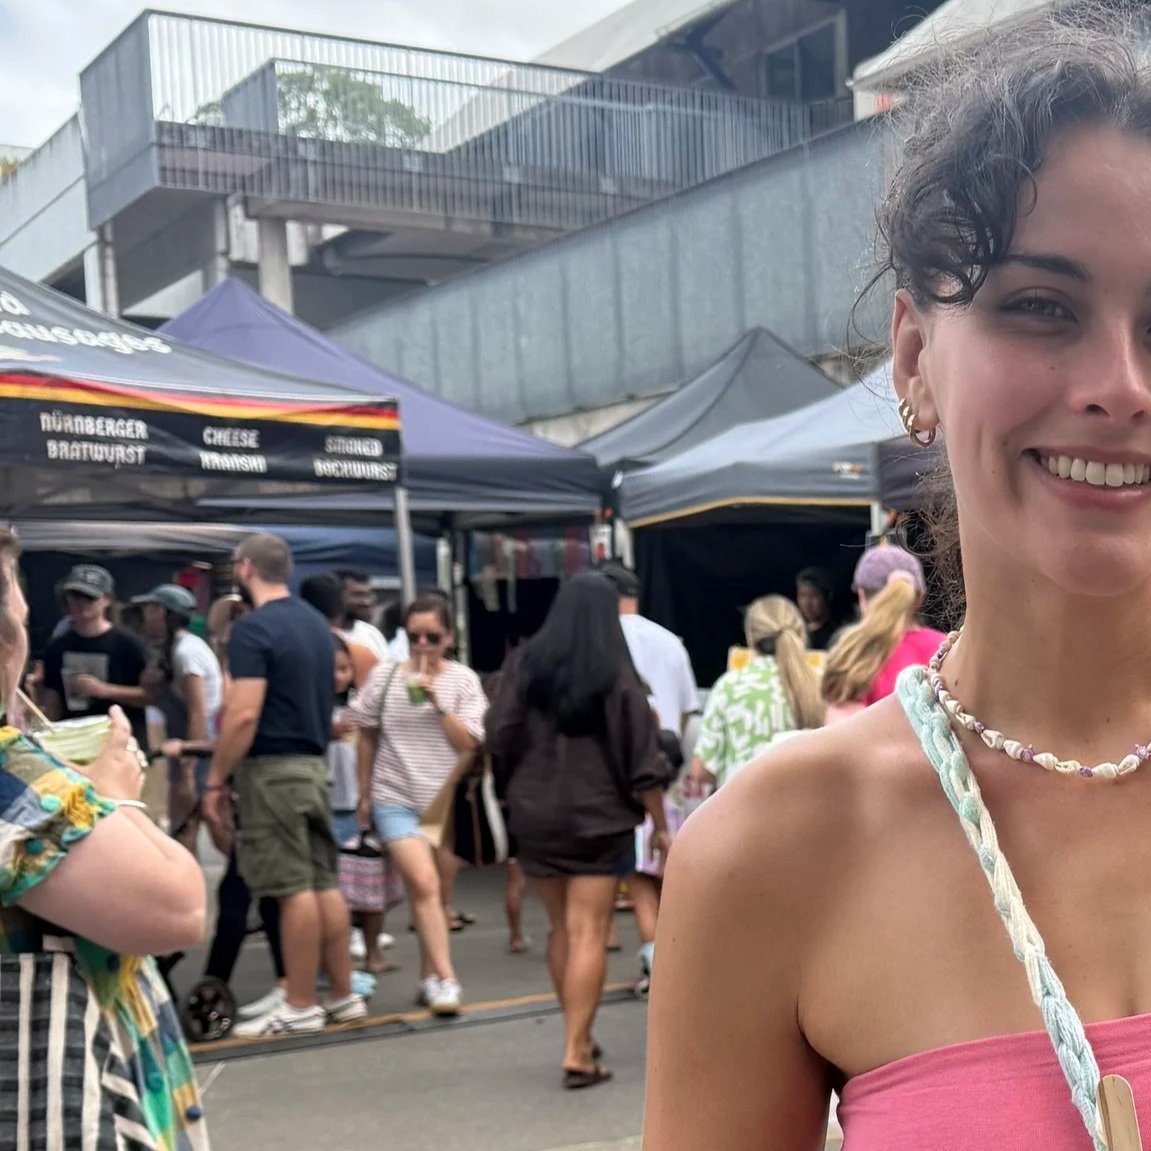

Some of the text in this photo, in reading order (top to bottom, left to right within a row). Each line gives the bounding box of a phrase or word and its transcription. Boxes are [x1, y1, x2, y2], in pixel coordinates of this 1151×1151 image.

[0, 320, 172, 354] ausages
[203, 426, 260, 449] CHEESE
[47, 439, 146, 468] BRATWURST
